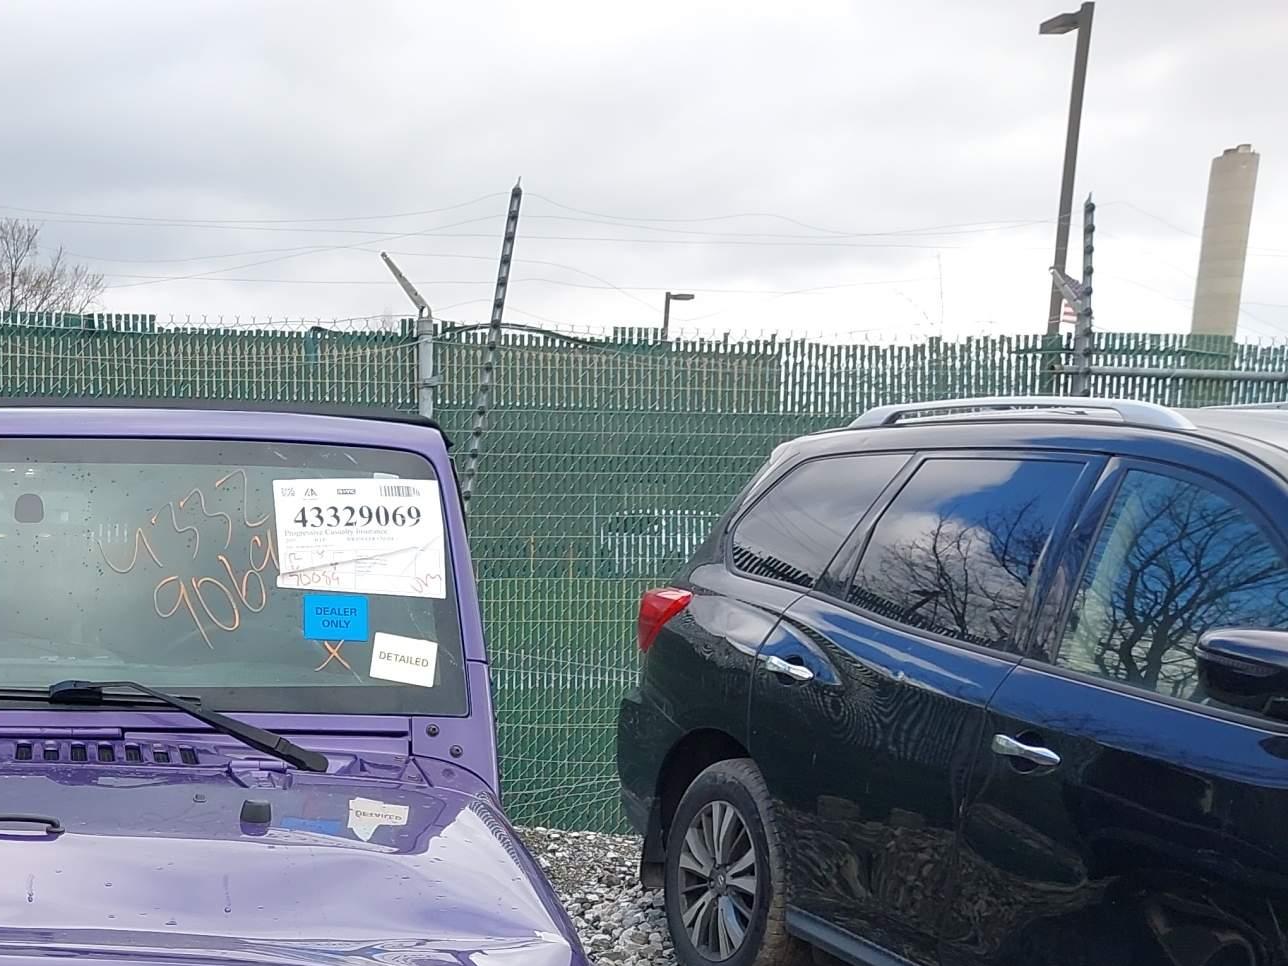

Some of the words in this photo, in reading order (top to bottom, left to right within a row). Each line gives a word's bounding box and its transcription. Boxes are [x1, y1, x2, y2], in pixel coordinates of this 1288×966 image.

[293, 505, 421, 528] 43329069
[315, 606, 357, 617] DEALER
[321, 618, 351, 629] ONLY
[378, 650, 429, 668] DETAILED
